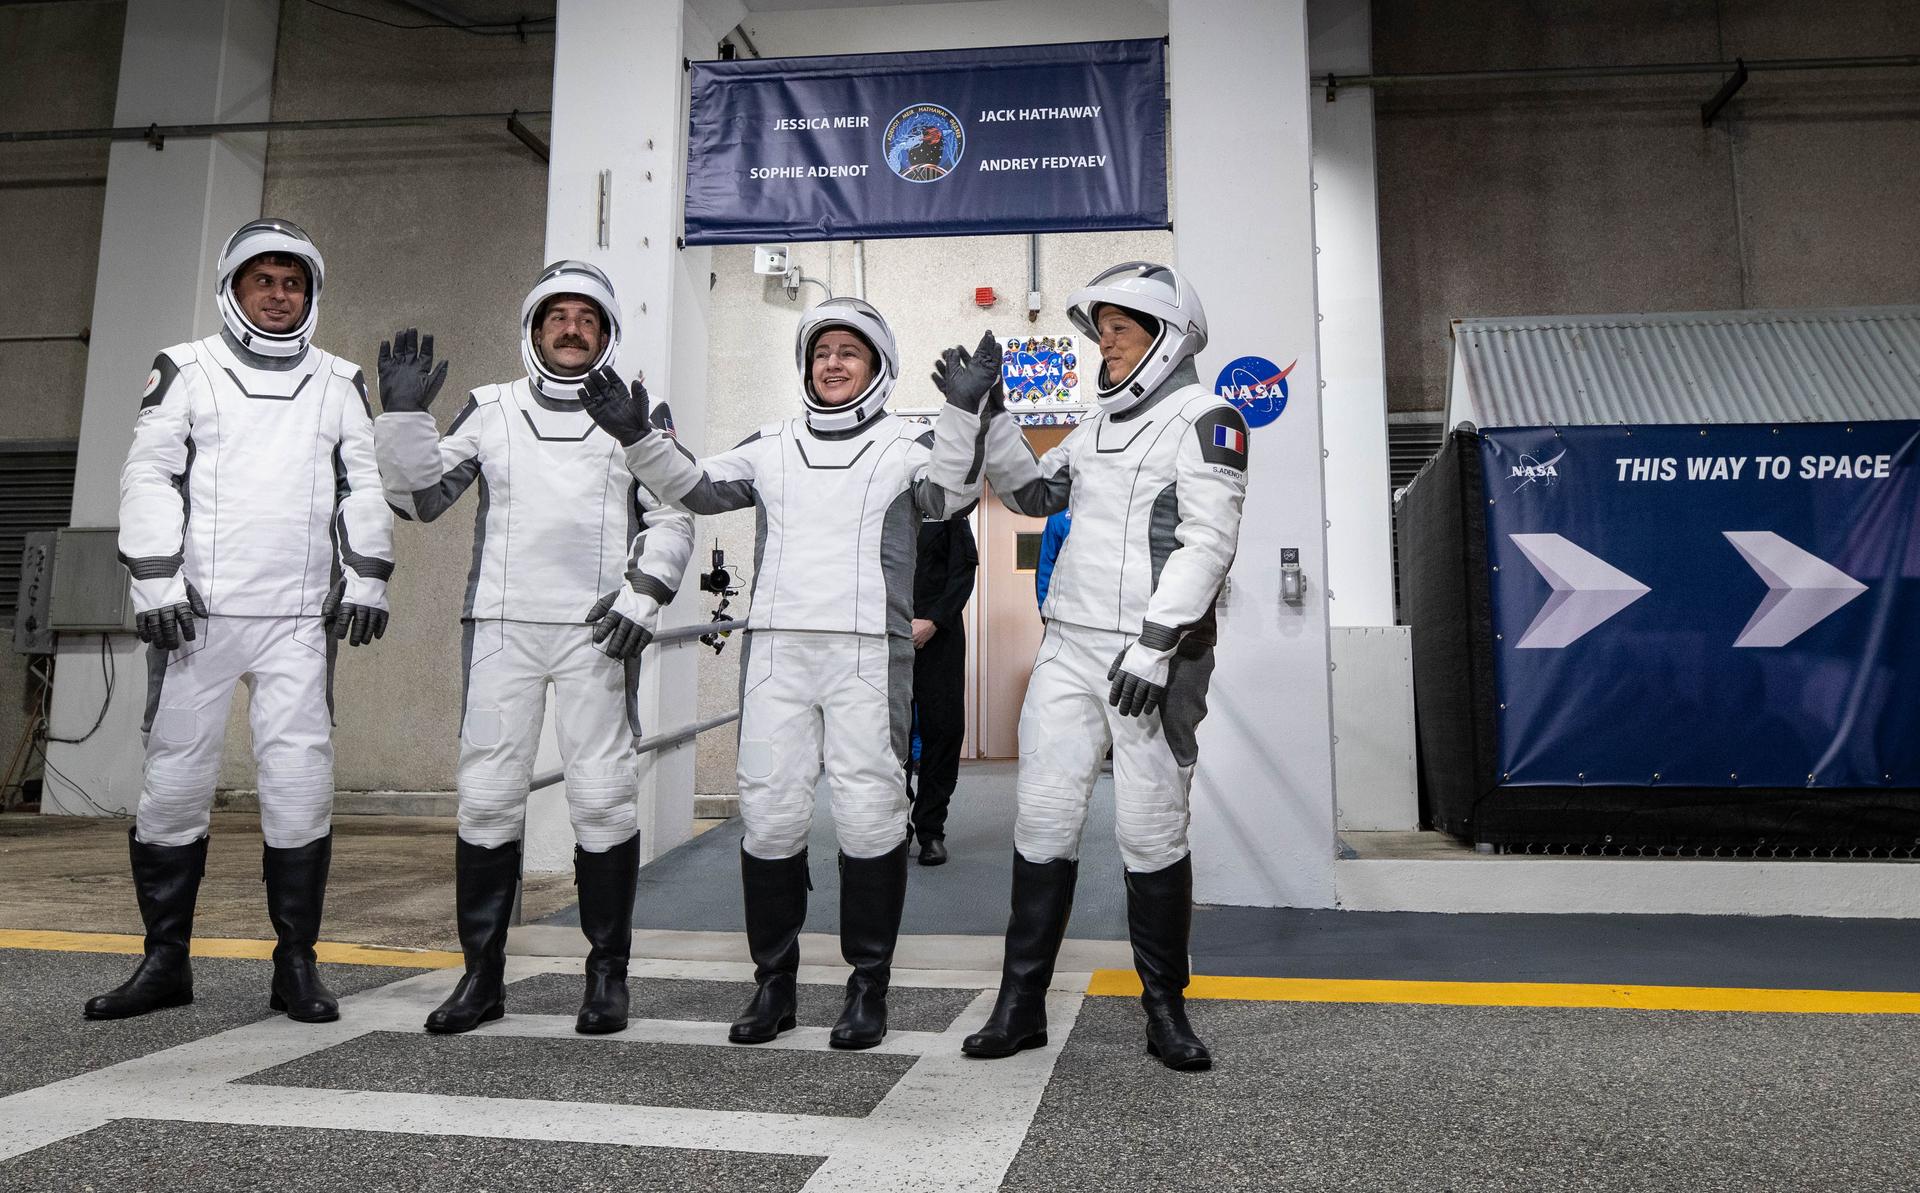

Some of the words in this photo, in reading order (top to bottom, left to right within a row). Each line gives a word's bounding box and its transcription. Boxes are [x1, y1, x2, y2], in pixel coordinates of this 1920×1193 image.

[979, 109, 1016, 122] JACK
[1019, 106, 1101, 120] HATHAWAY
[774, 118, 830, 131] JESSICA
[834, 116, 869, 129] MEIR
[887, 119, 900, 141] ADENOT
[901, 109, 914, 119] MEIR
[918, 106, 948, 118] HATHAWAY
[979, 158, 1039, 171] ANDREY
[1042, 155, 1107, 169] FEDYAEV
[750, 166, 804, 179] SOPHIE
[807, 165, 869, 178] ADENOT
[1007, 364, 1060, 378] NASA
[1220, 384, 1285, 400] NASA
[1212, 466, 1244, 481] S.ADENOT
[1511, 465, 1558, 477] NASA
[1616, 457, 1678, 482] THIS
[1686, 456, 1748, 481] WAY
[1755, 456, 1791, 480] TO
[1799, 454, 1891, 480] SPACE
